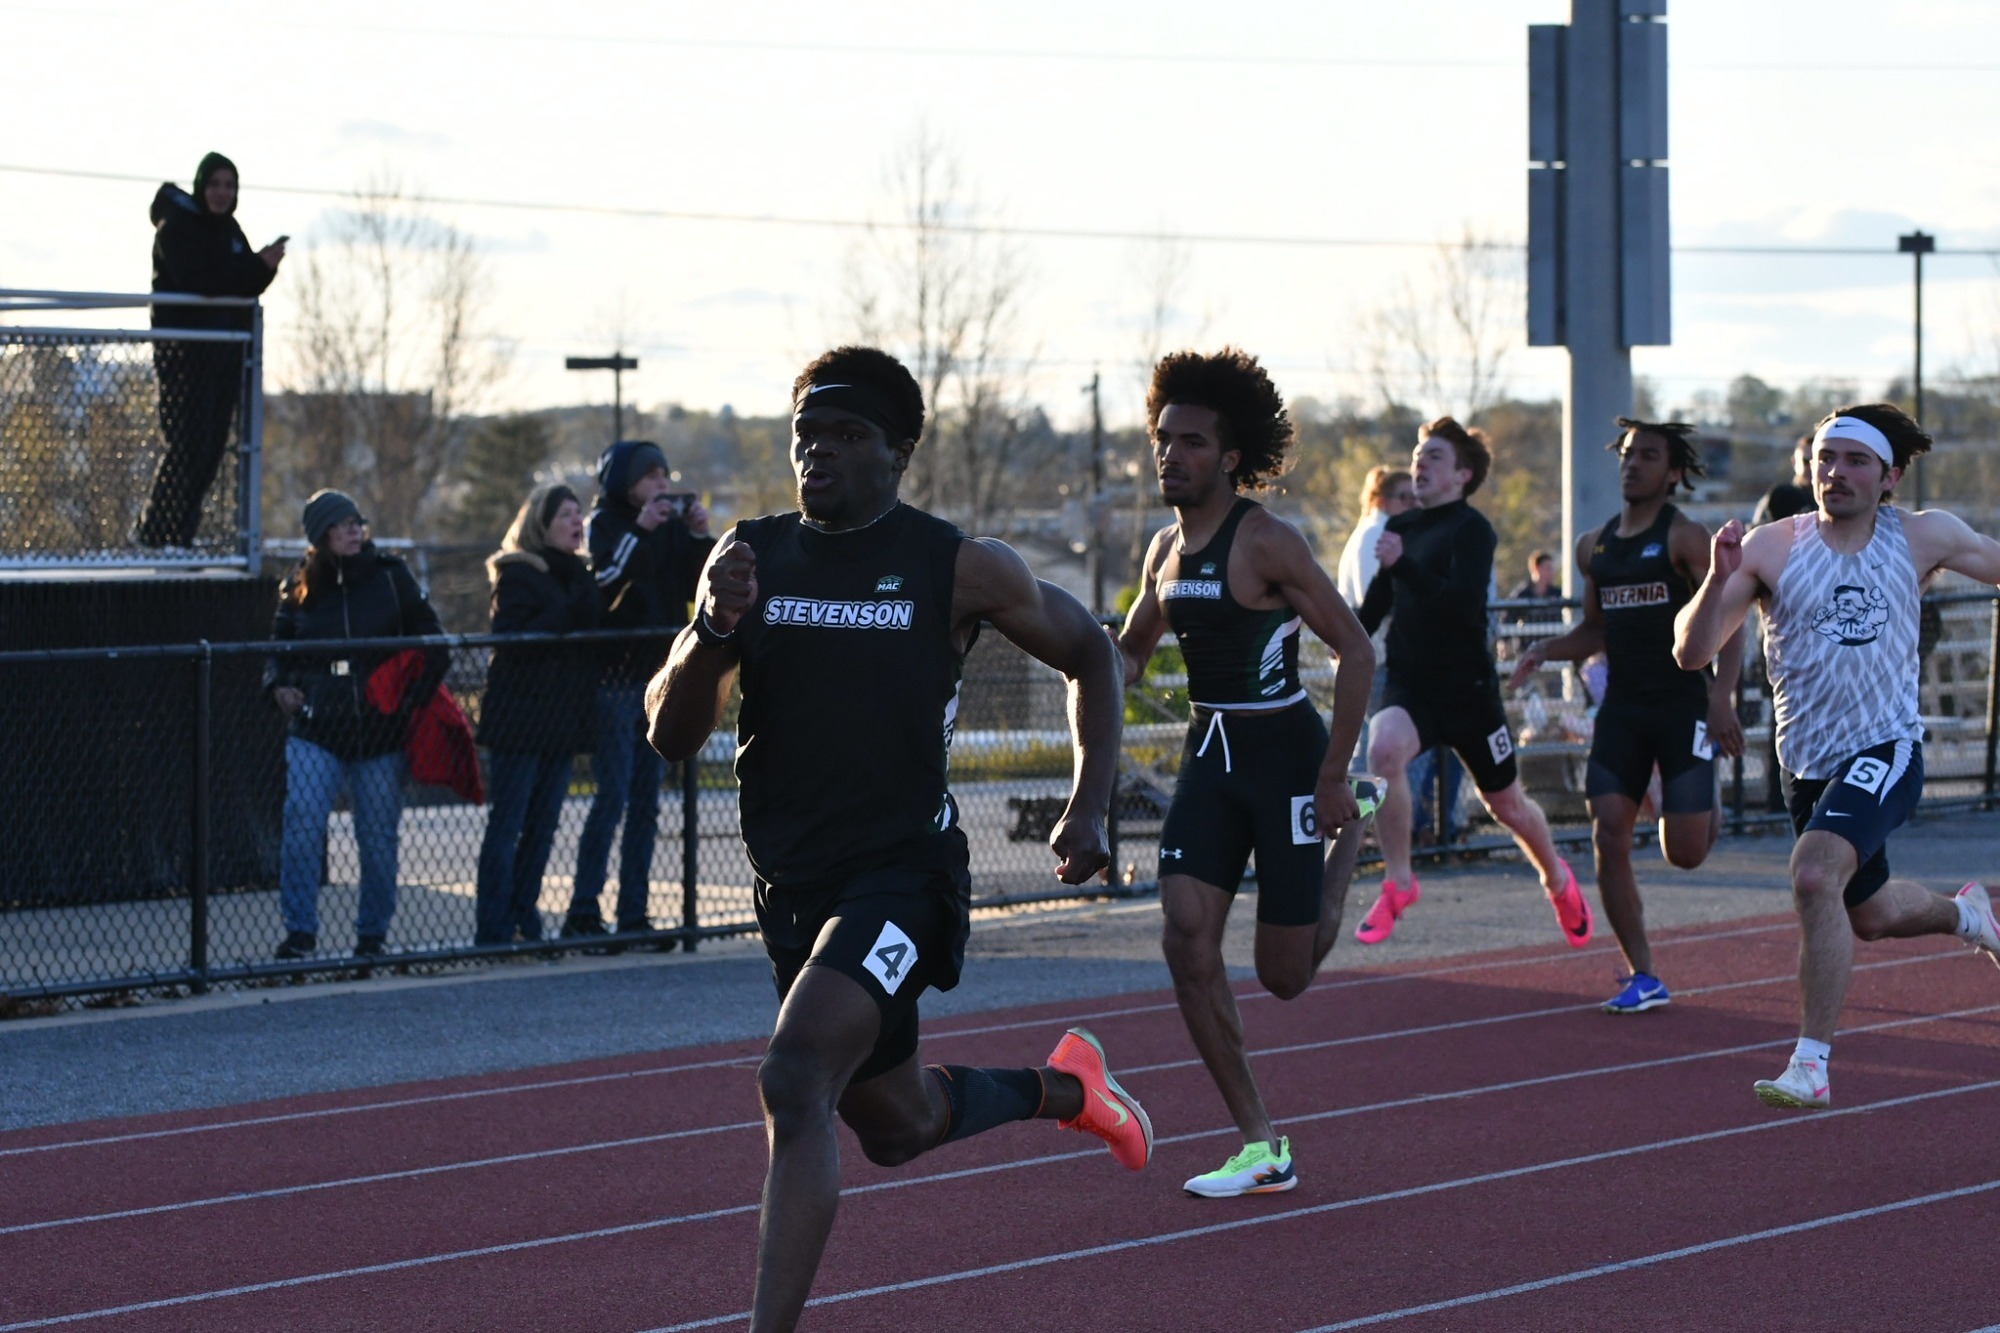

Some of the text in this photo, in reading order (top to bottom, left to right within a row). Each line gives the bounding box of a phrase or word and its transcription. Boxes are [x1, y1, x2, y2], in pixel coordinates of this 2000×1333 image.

[764, 596, 913, 629] STEVENSON
[1496, 733, 1507, 755] 8
[1852, 761, 1879, 784] 5
[1300, 801, 1316, 837] 6
[875, 942, 908, 981] 4
